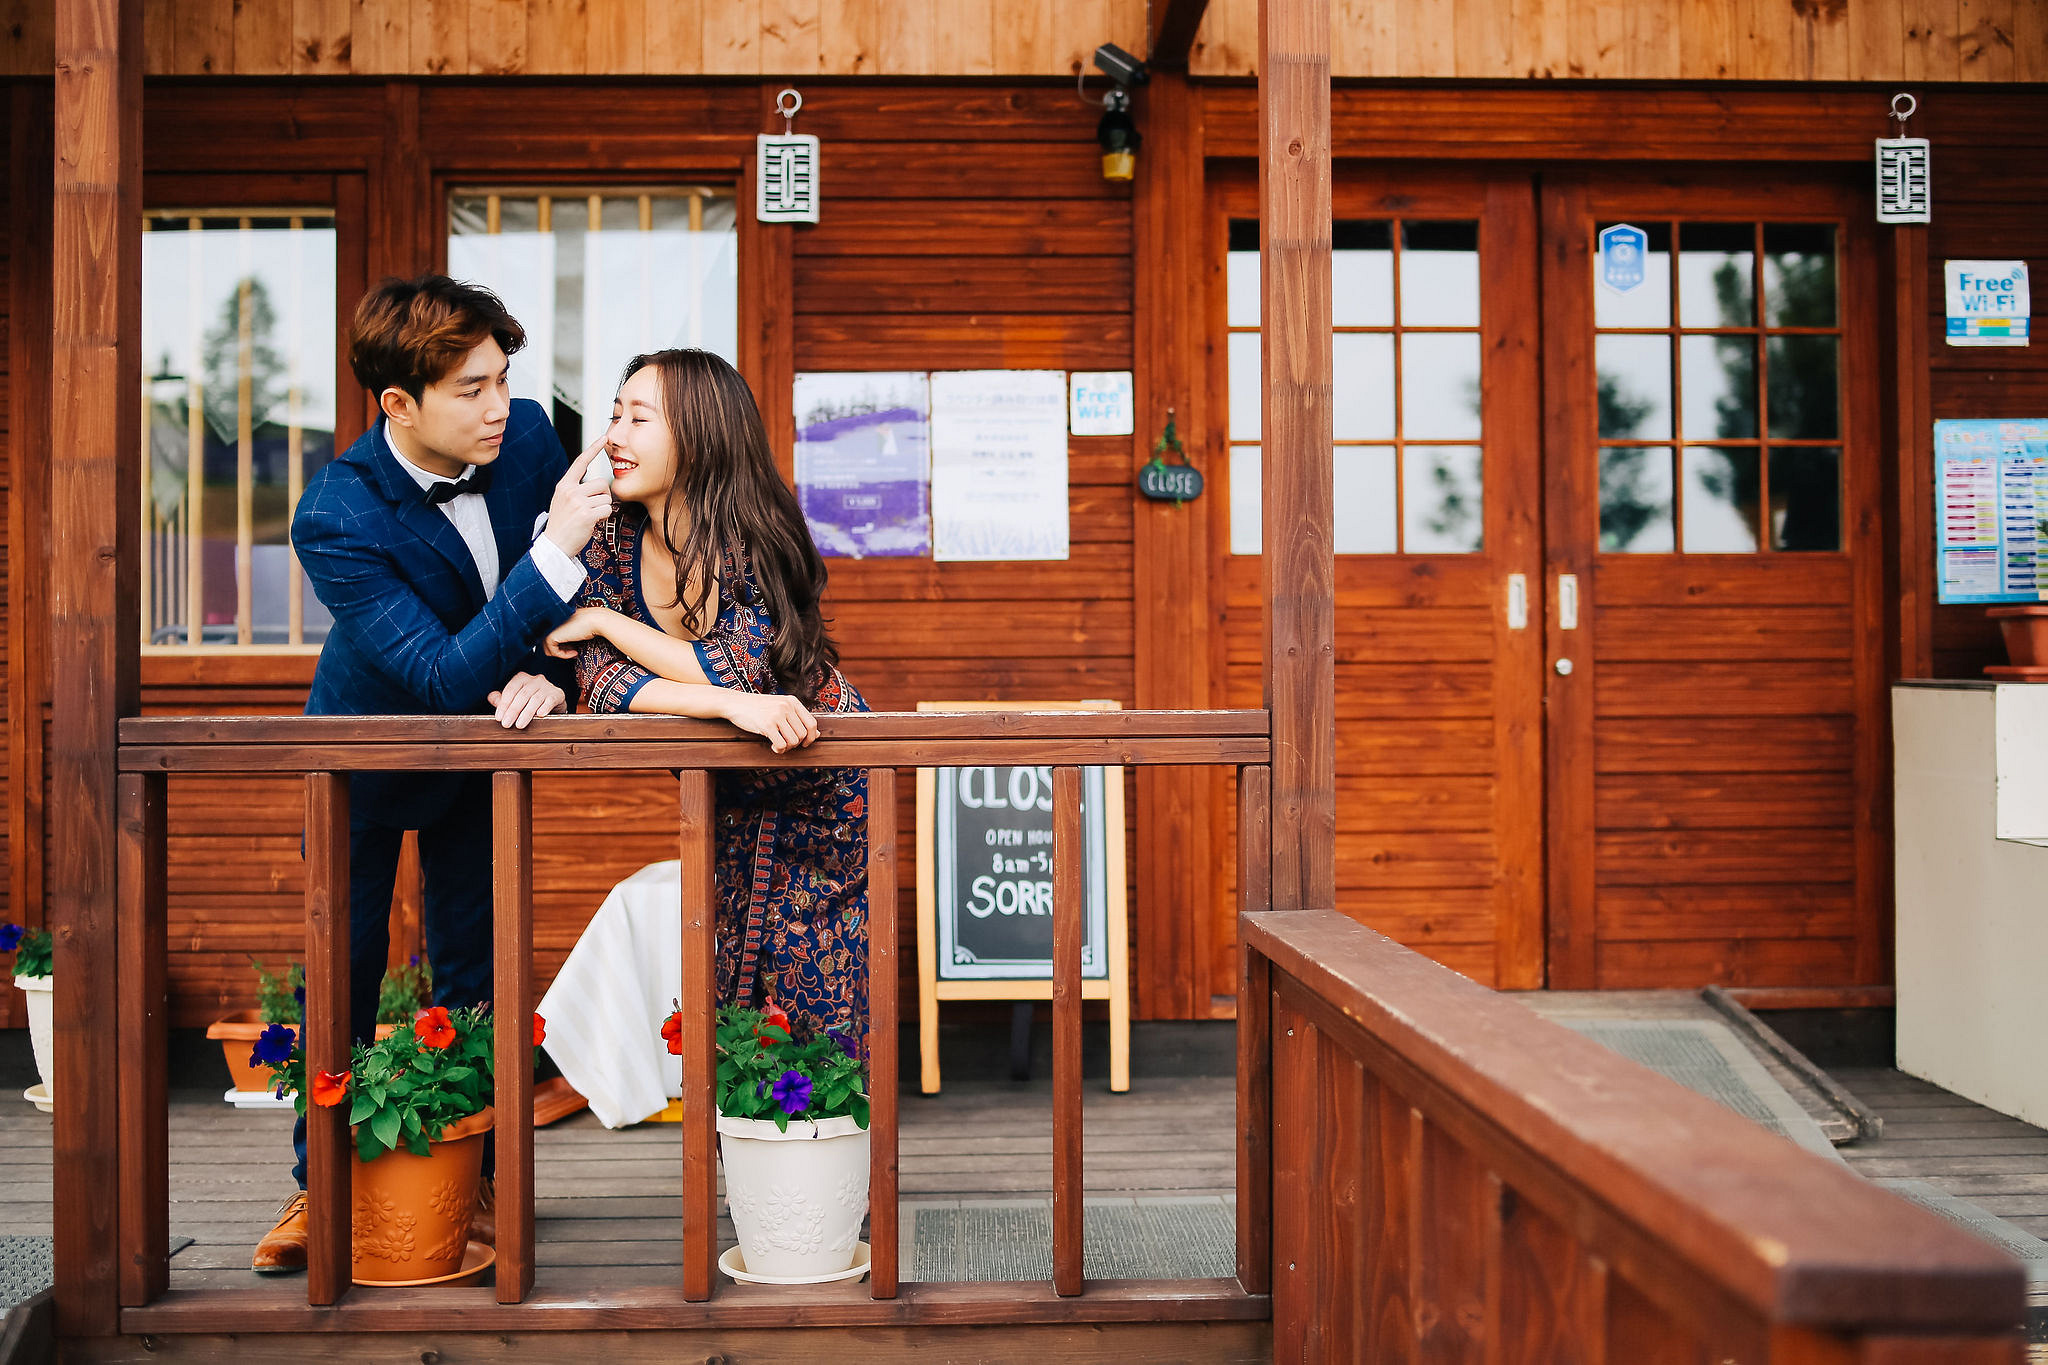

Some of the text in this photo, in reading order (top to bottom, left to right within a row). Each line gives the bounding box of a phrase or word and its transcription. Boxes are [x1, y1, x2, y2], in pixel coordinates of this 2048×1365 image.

[1960, 273, 2014, 291] Free
[1961, 295, 2016, 311] Wi-Fi
[1076, 388, 1119, 402] Free
[1078, 405, 1121, 419] Wi-Fi
[1147, 471, 1193, 494] CLOSE
[958, 766, 1053, 812] CLOS
[985, 829, 1053, 846] OPEN HOU
[992, 851, 1053, 875] 8am-5
[966, 875, 1053, 919] SORR
